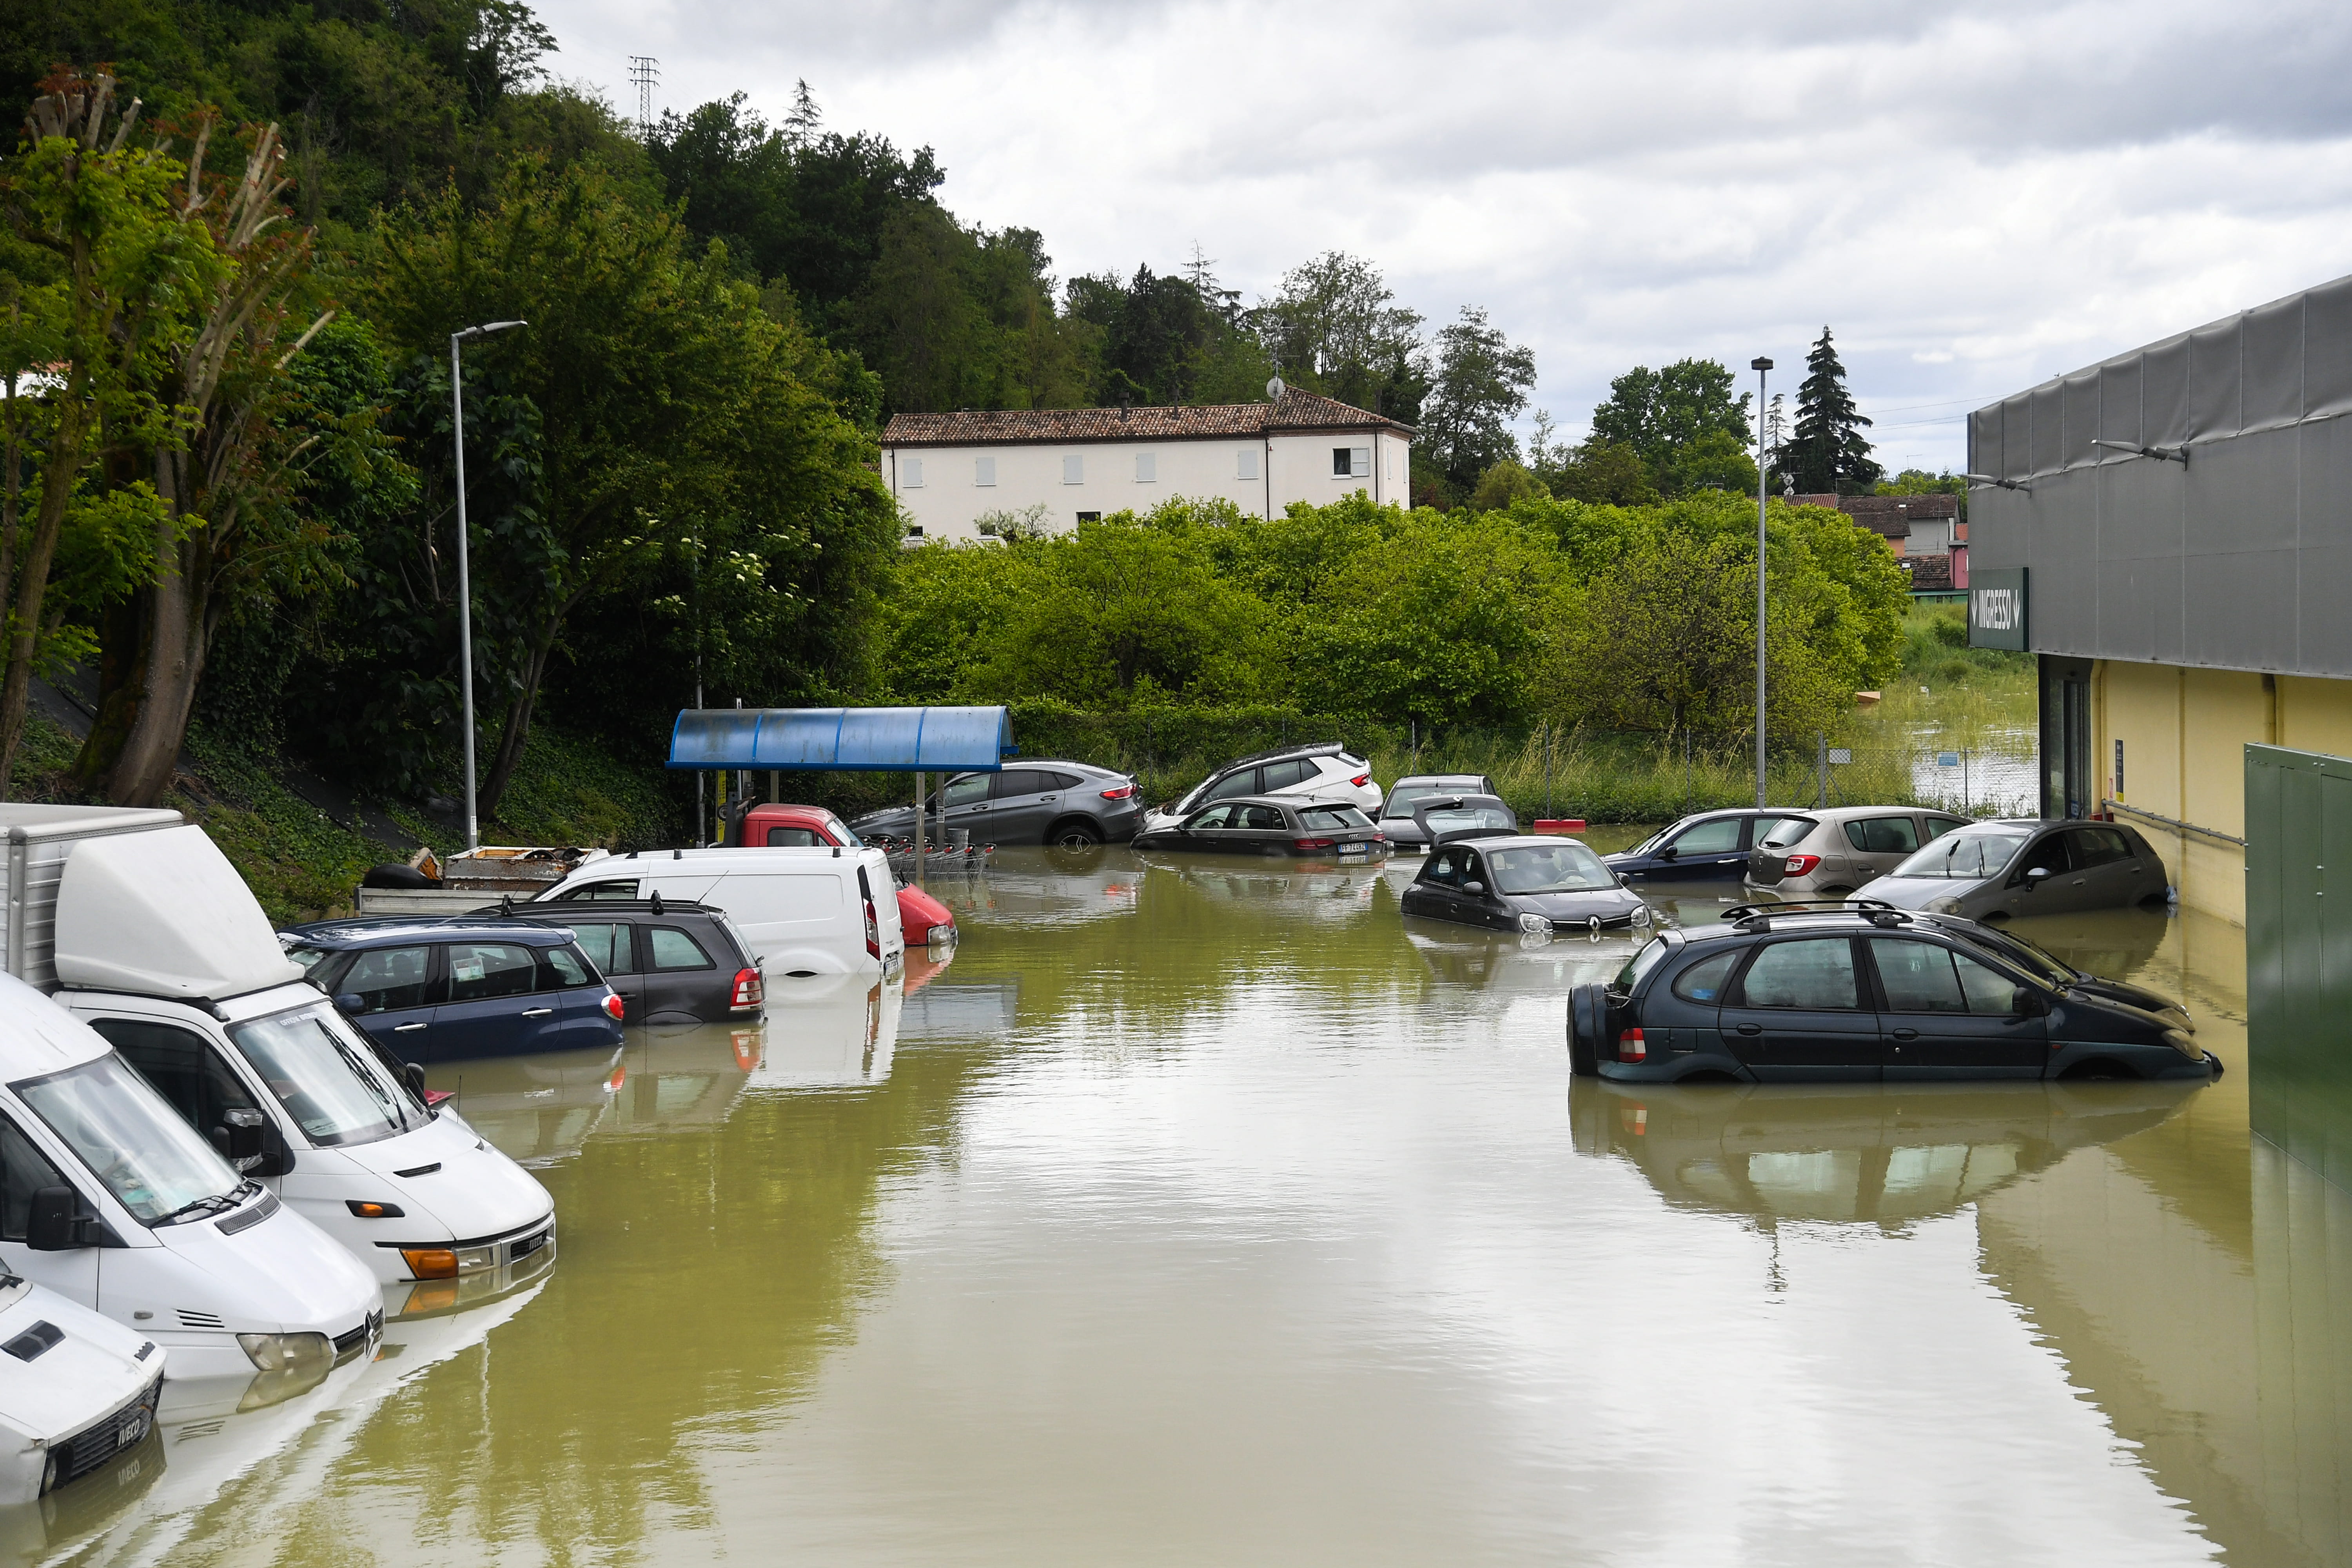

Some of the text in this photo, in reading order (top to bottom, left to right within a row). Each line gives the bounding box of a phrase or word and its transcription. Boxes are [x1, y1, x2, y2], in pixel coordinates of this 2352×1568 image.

[1979, 589, 2011, 630] INGRESSO
[529, 1235, 543, 1250] IVECO
[118, 1418, 140, 1446] IVECO
